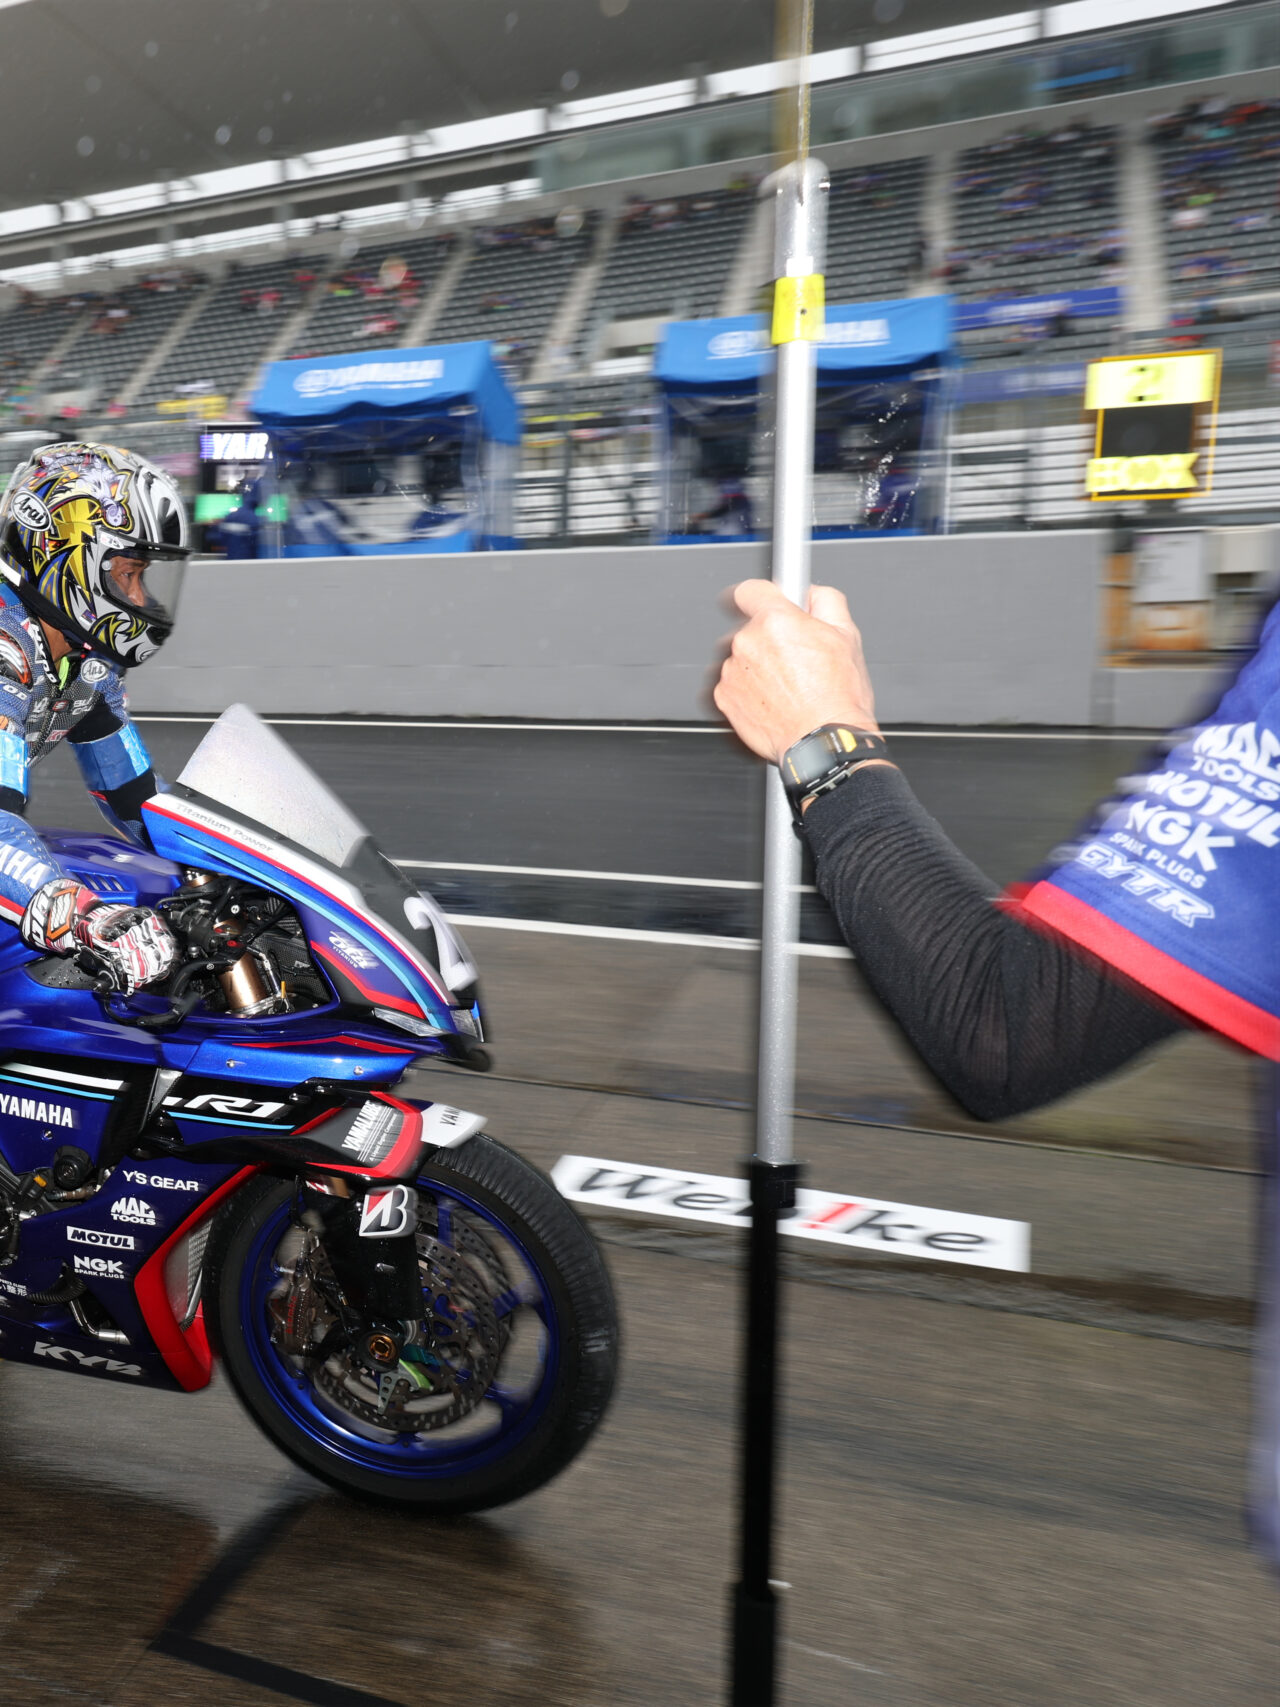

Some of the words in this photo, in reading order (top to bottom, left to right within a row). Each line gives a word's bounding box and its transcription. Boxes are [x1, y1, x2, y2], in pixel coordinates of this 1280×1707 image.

[17, 497, 47, 524] Arai
[1125, 799, 1236, 872] NGK
[1146, 849, 1207, 889] PLUGS
[1075, 842, 1216, 928] GYTR
[341, 1100, 381, 1152] YAMALUBE
[123, 1170, 148, 1185] Y'S
[150, 1175, 199, 1191] GEAR
[110, 1197, 156, 1219] MAC
[111, 1214, 157, 1226] TOOLS
[71, 1229, 132, 1248] MOTUL
[73, 1255, 124, 1274] NGK
[74, 1268, 98, 1277] SPARK
[99, 1272, 125, 1280] PLUGS
[33, 1341, 142, 1376] KYB
